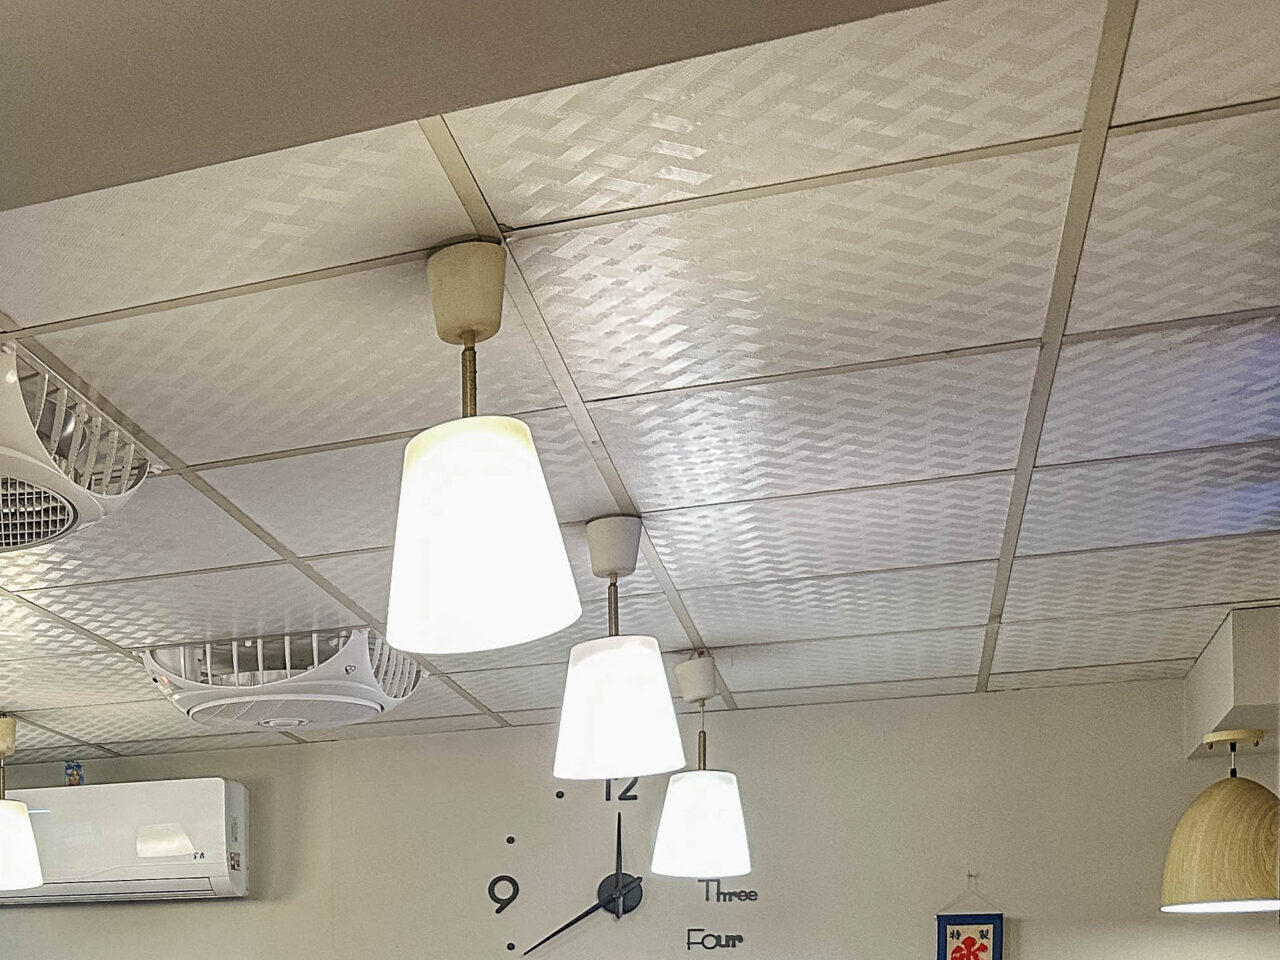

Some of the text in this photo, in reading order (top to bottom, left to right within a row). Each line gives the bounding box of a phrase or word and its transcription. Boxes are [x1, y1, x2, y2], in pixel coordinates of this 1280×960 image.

[487, 874, 520, 914] 9
[697, 879, 759, 902] Three
[686, 928, 744, 950] Four
